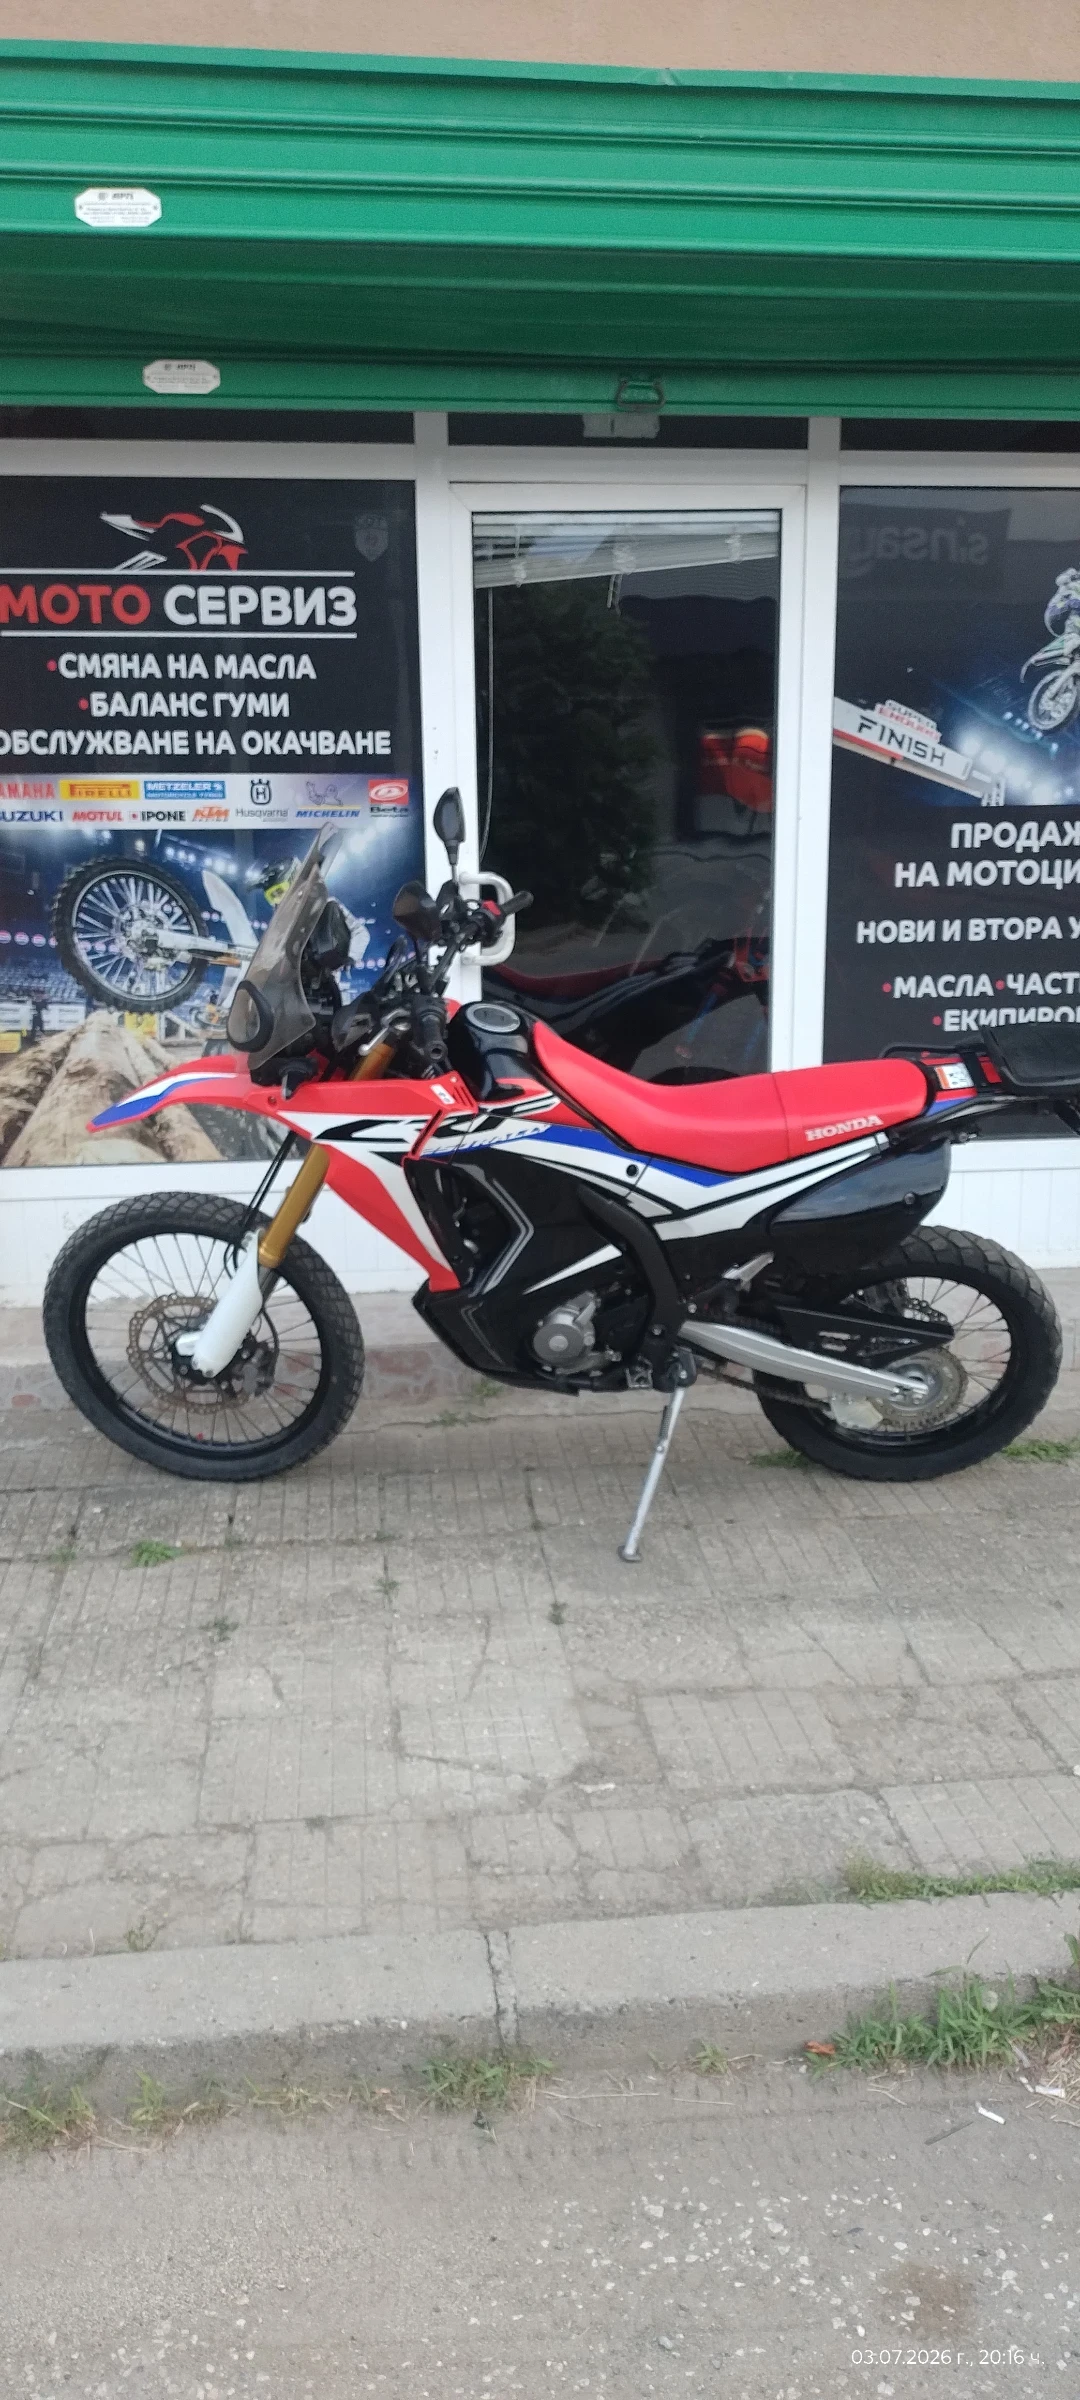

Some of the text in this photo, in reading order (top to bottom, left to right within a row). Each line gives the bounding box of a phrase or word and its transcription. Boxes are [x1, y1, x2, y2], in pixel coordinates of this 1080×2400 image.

[0, 584, 357, 627] МОТО СЕРВИЗ
[58, 652, 317, 680] СМЯНА НА МАСЛА
[90, 691, 290, 719] БАЛАНС ГУМИ
[0, 729, 392, 756] ОБСЛУЖВАНЕ НА ОКАЧВАНЕ
[857, 714, 946, 767] FINISH
[69, 783, 132, 798] PIRELLI
[147, 782, 212, 791] METZELER
[72, 810, 123, 822] MOTUL
[141, 810, 186, 821] IPONE
[194, 807, 230, 818] KTM
[235, 808, 289, 819] Husqvarna
[296, 810, 360, 818] MICHELIN
[894, 861, 940, 888] НА
[856, 919, 936, 944] НОВИ
[941, 918, 962, 942] И
[968, 916, 1063, 942] ВТОРА
[892, 973, 995, 999] МАСЛА
[804, 1114, 884, 1142] HONDA
